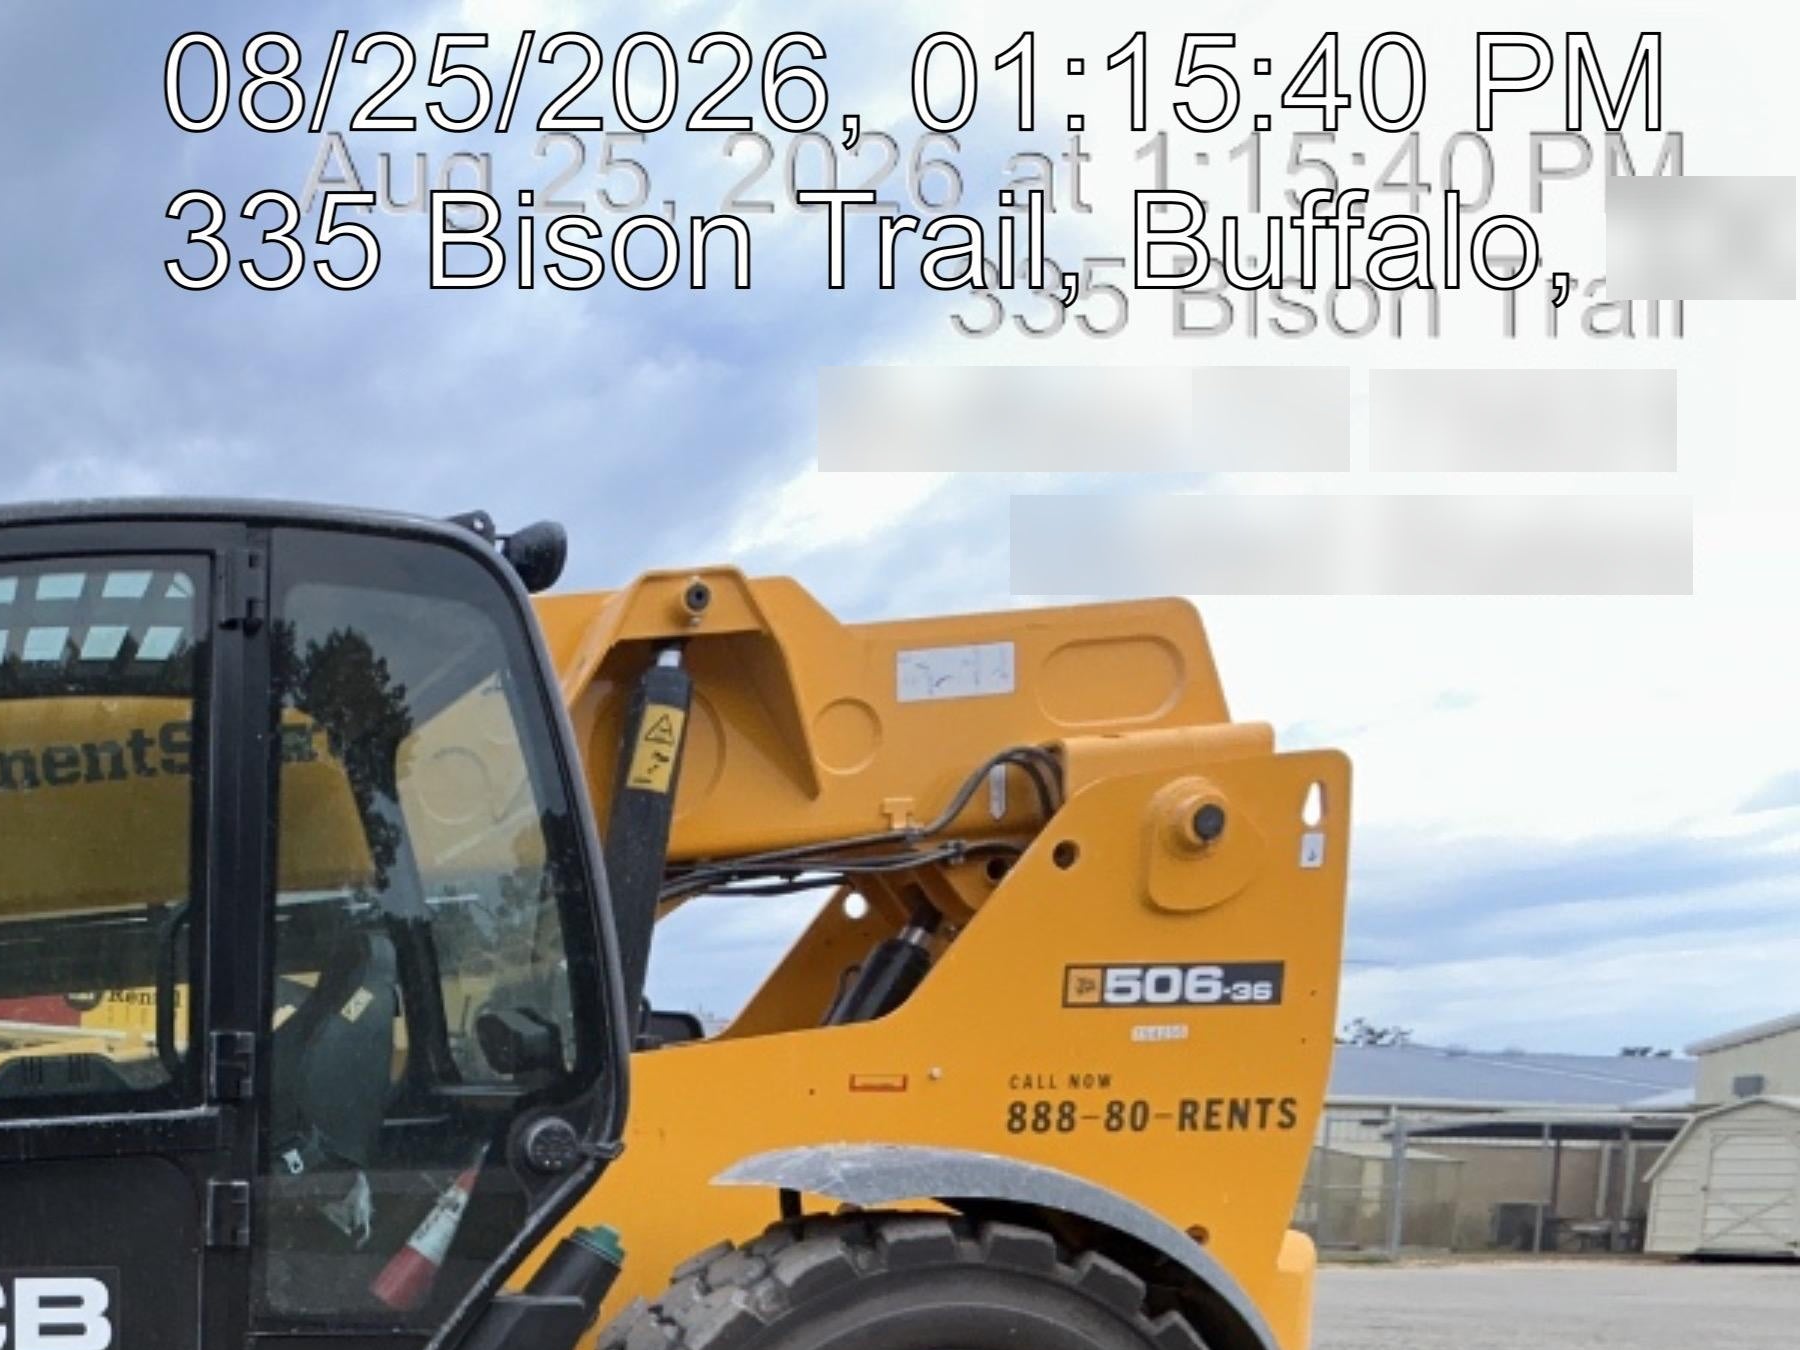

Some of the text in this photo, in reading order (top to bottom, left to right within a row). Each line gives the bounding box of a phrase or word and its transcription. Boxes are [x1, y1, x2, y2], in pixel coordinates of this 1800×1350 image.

[1103, 966, 1273, 1004] 506-36
[1008, 1073, 1112, 1090] CALL NOW
[1006, 1097, 1298, 1135] 888-80-RENTS
